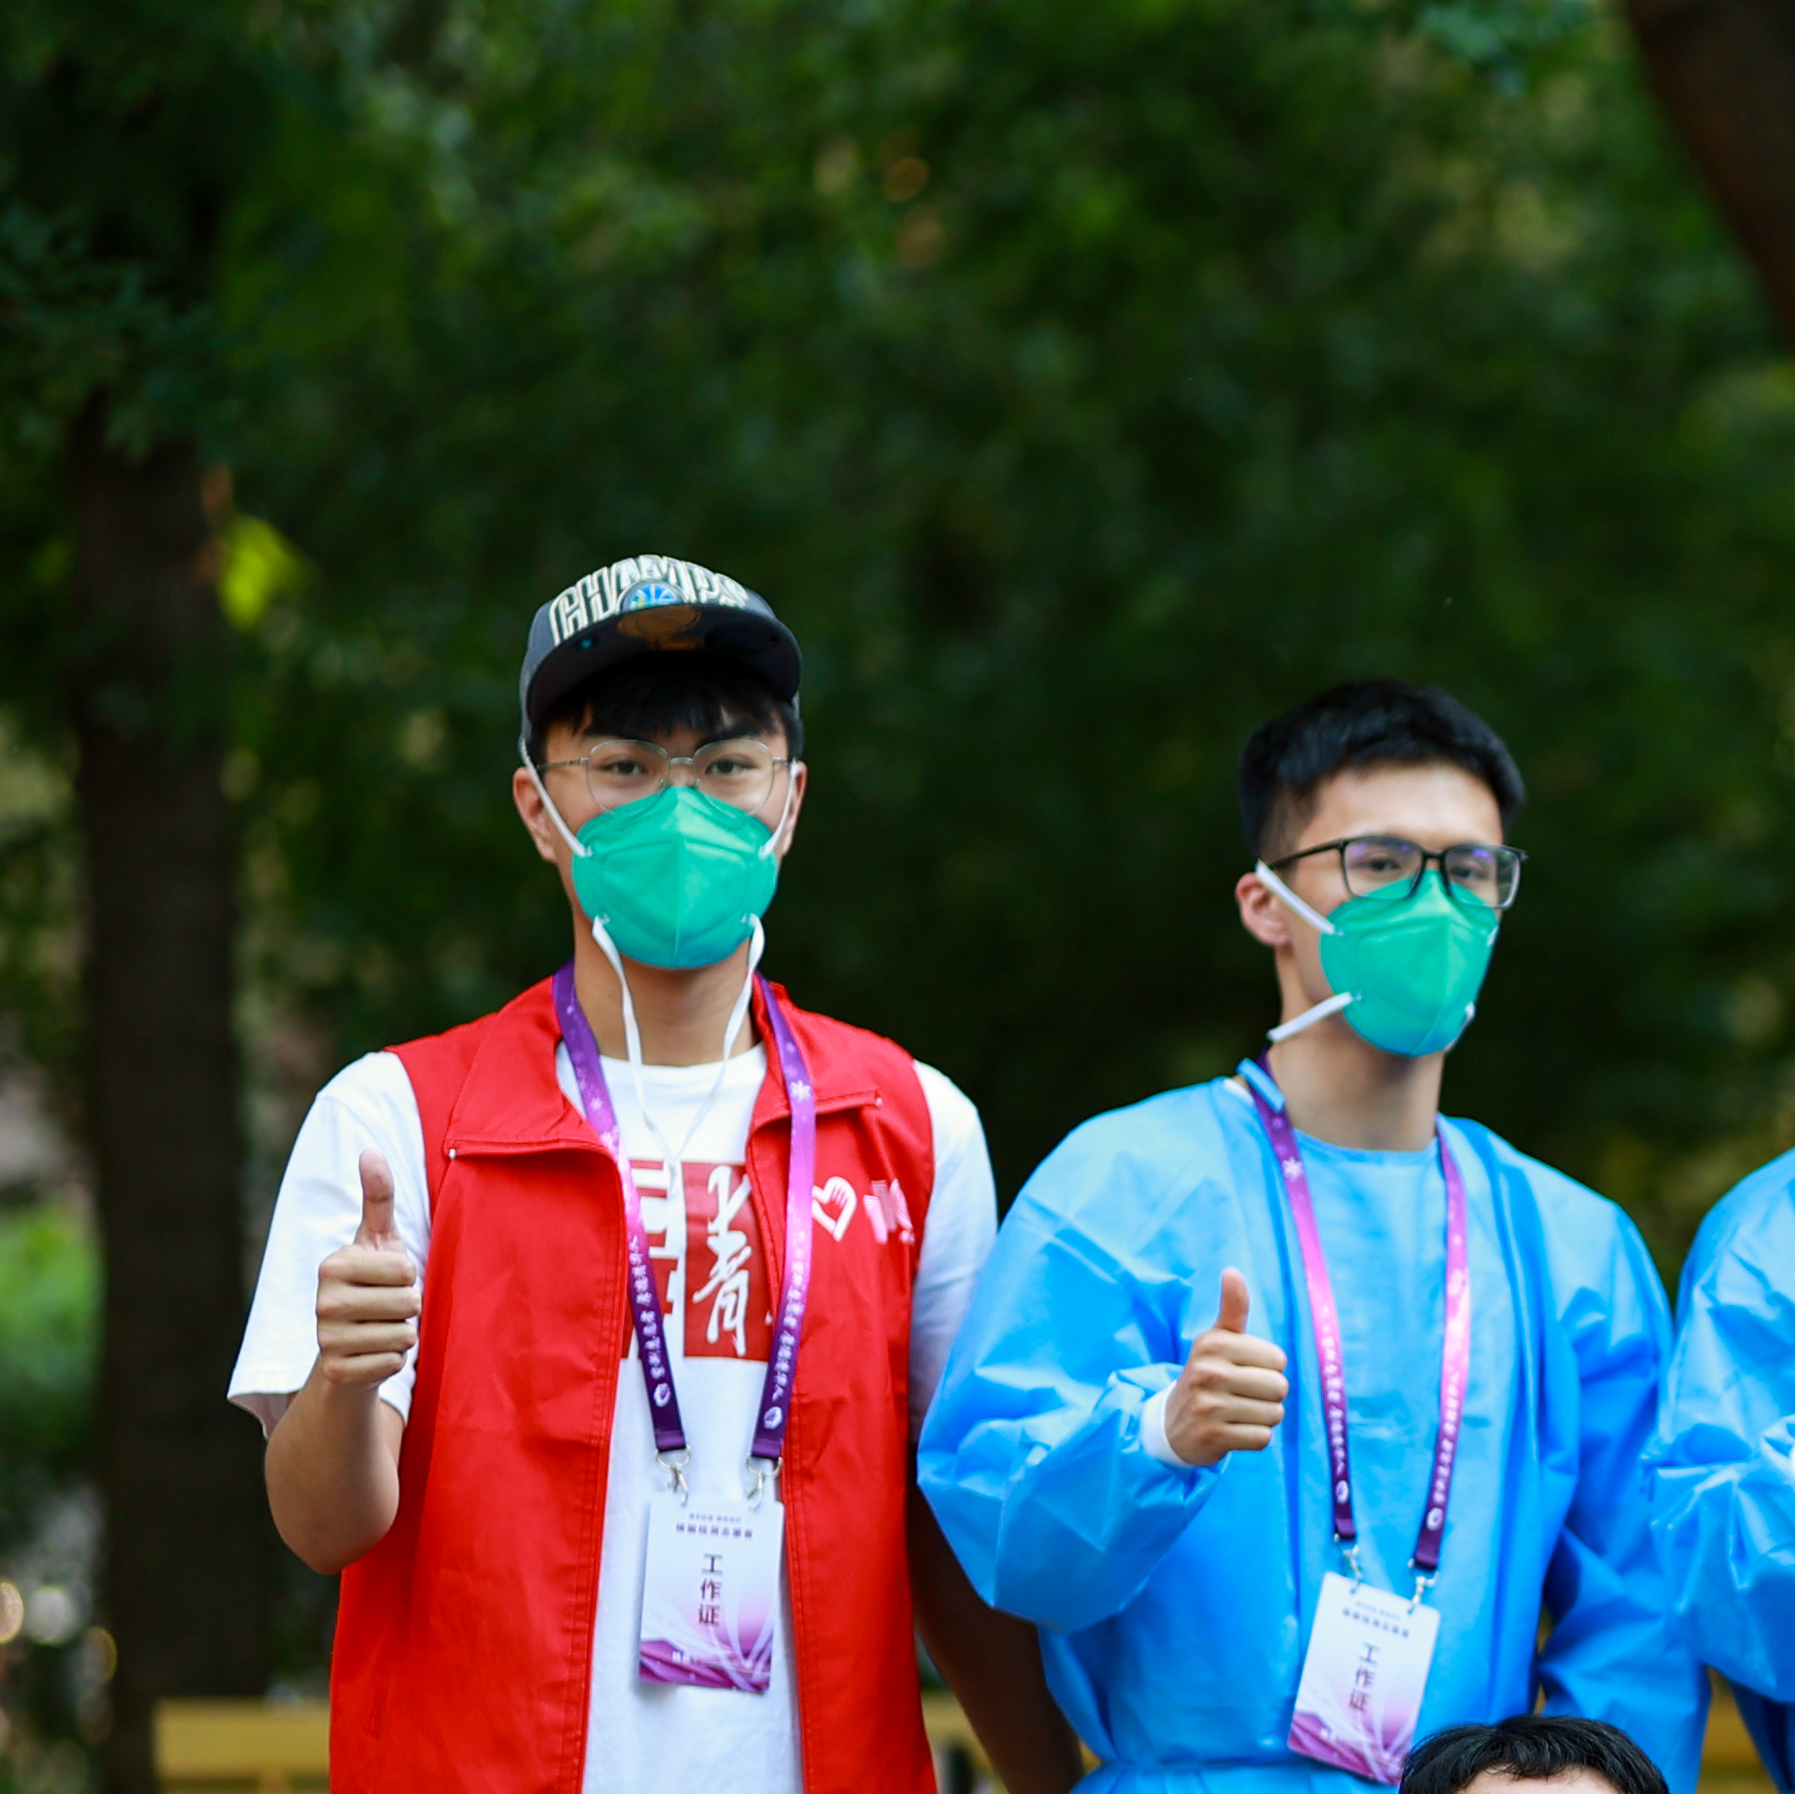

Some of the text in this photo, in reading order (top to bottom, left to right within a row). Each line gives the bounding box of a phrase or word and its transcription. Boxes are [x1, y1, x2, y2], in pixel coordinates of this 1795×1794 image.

[548, 554, 750, 646] CHAMPS
[698, 1553, 723, 1626] 工作证
